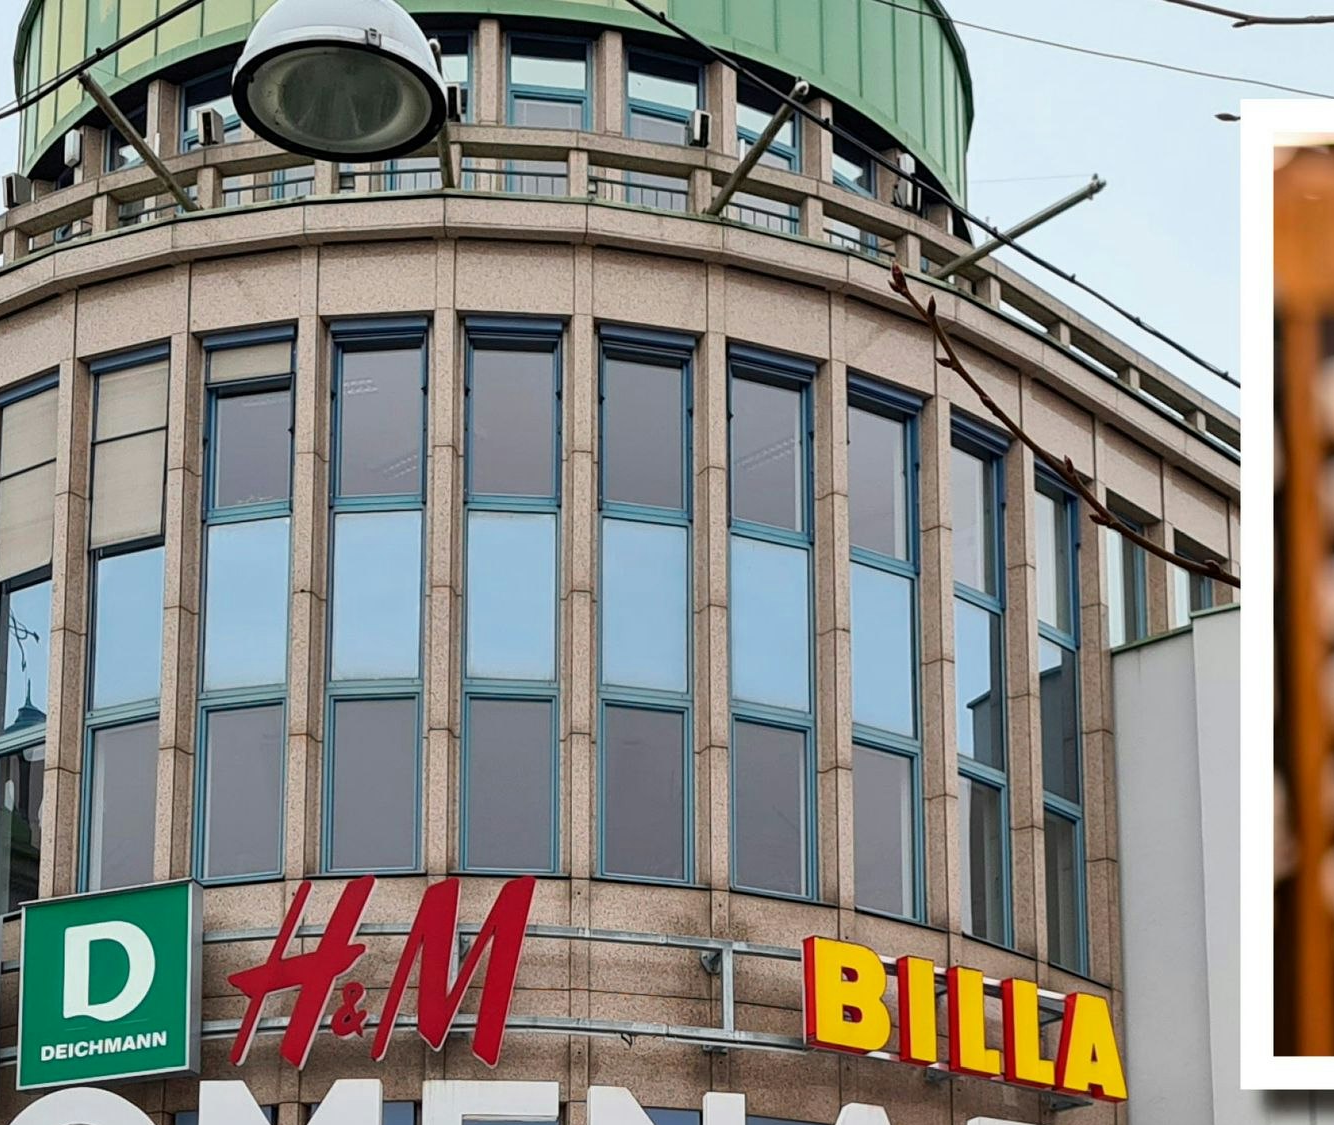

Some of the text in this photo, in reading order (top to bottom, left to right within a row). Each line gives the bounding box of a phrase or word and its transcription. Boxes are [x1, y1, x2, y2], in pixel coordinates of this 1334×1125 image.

[63, 919, 155, 1021] D
[227, 874, 536, 1071] H&M
[802, 935, 1129, 1104] BILLA
[39, 1028, 167, 1063] DEICHMANN
